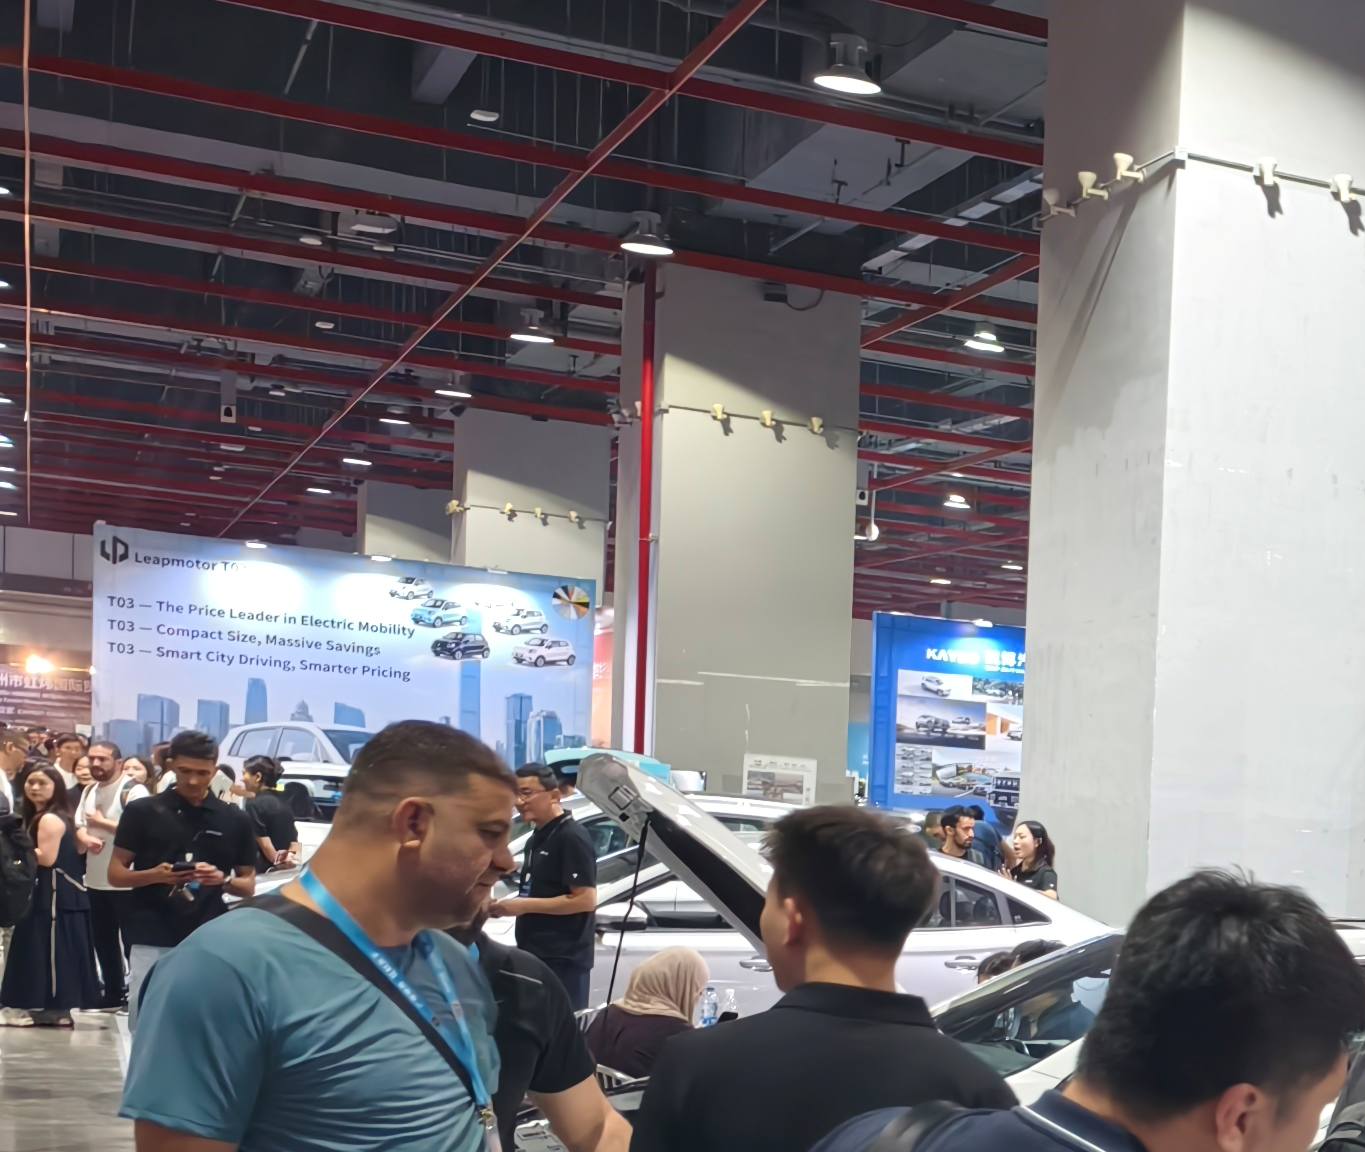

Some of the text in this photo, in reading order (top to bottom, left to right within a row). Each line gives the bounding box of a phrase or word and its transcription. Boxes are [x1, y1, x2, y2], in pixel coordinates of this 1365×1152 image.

[134, 551, 218, 572] Leapmotor
[107, 595, 135, 609] T03
[156, 601, 184, 614] The
[189, 604, 225, 618] Price
[230, 608, 280, 623] Leader
[283, 613, 297, 625] in
[301, 615, 354, 631] Electric
[358, 621, 415, 638] Mobility
[108, 619, 135, 632] T03
[156, 623, 223, 641] Compact
[227, 630, 262, 645] Size,
[266, 634, 322, 650] Massive
[326, 640, 381, 657] Savings
[108, 642, 135, 655] T03
[156, 646, 202, 661] Smart
[206, 651, 235, 666] City
[239, 654, 296, 672] Driving,
[300, 659, 358, 675] Smarter
[362, 665, 411, 682] Pricing
